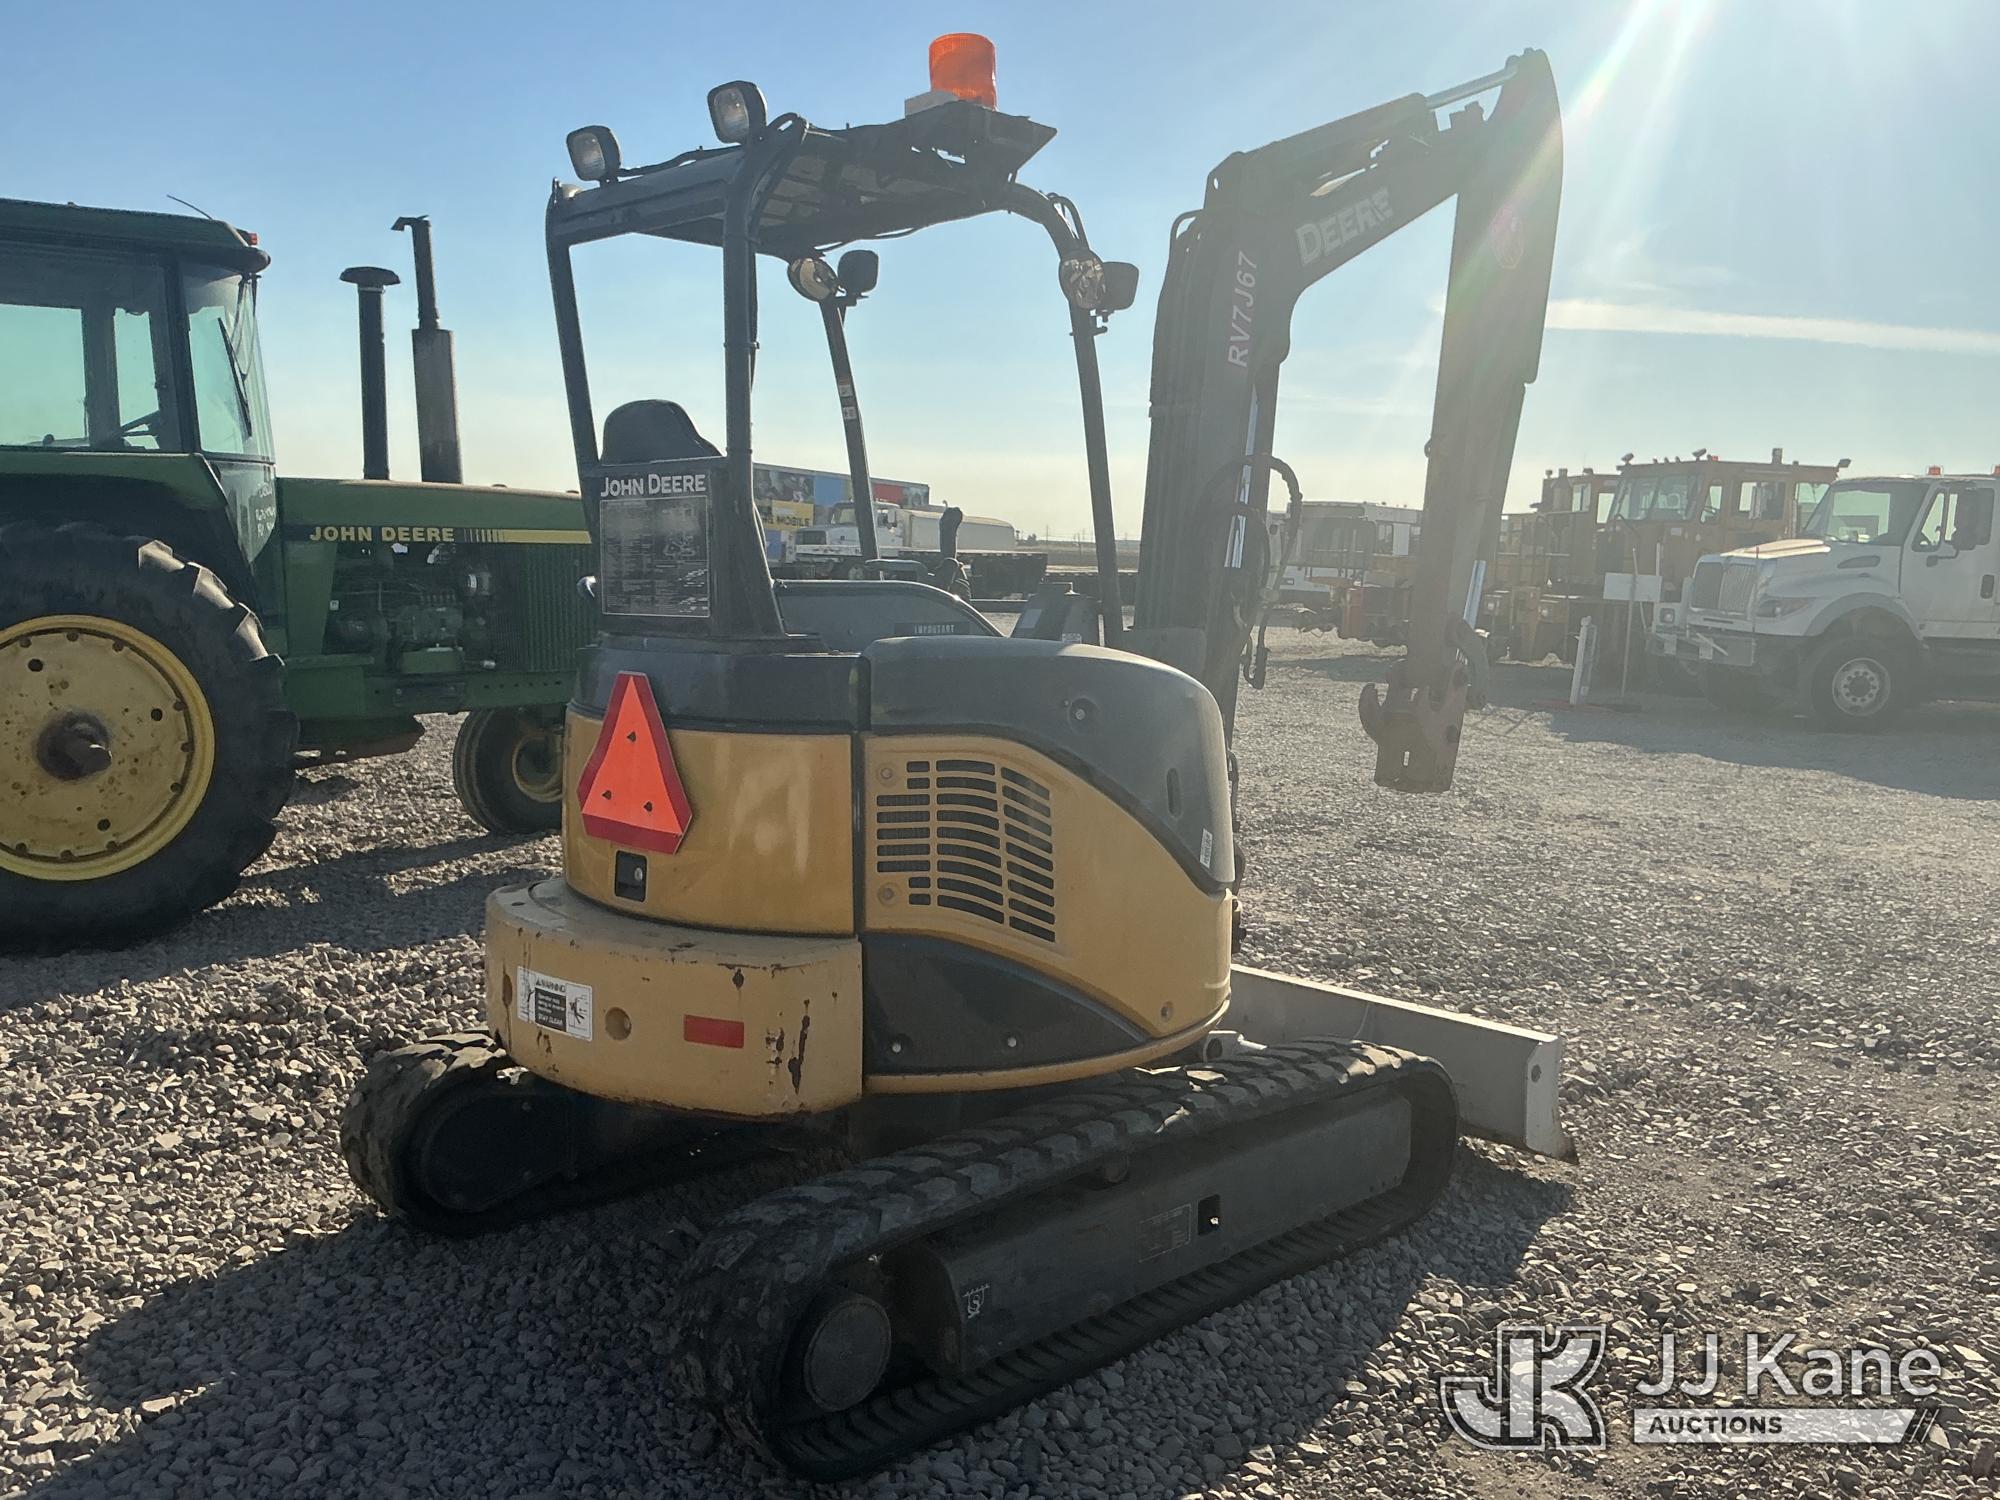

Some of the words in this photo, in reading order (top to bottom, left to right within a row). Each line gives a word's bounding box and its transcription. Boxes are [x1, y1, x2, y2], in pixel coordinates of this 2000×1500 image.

[1296, 188, 1393, 265] DEERE
[1228, 251, 1257, 367] RV7J67
[601, 477, 643, 497] JOHN
[648, 474, 706, 494] DEERE
[309, 526, 372, 541] JOHN
[381, 527, 454, 542] DEERE
